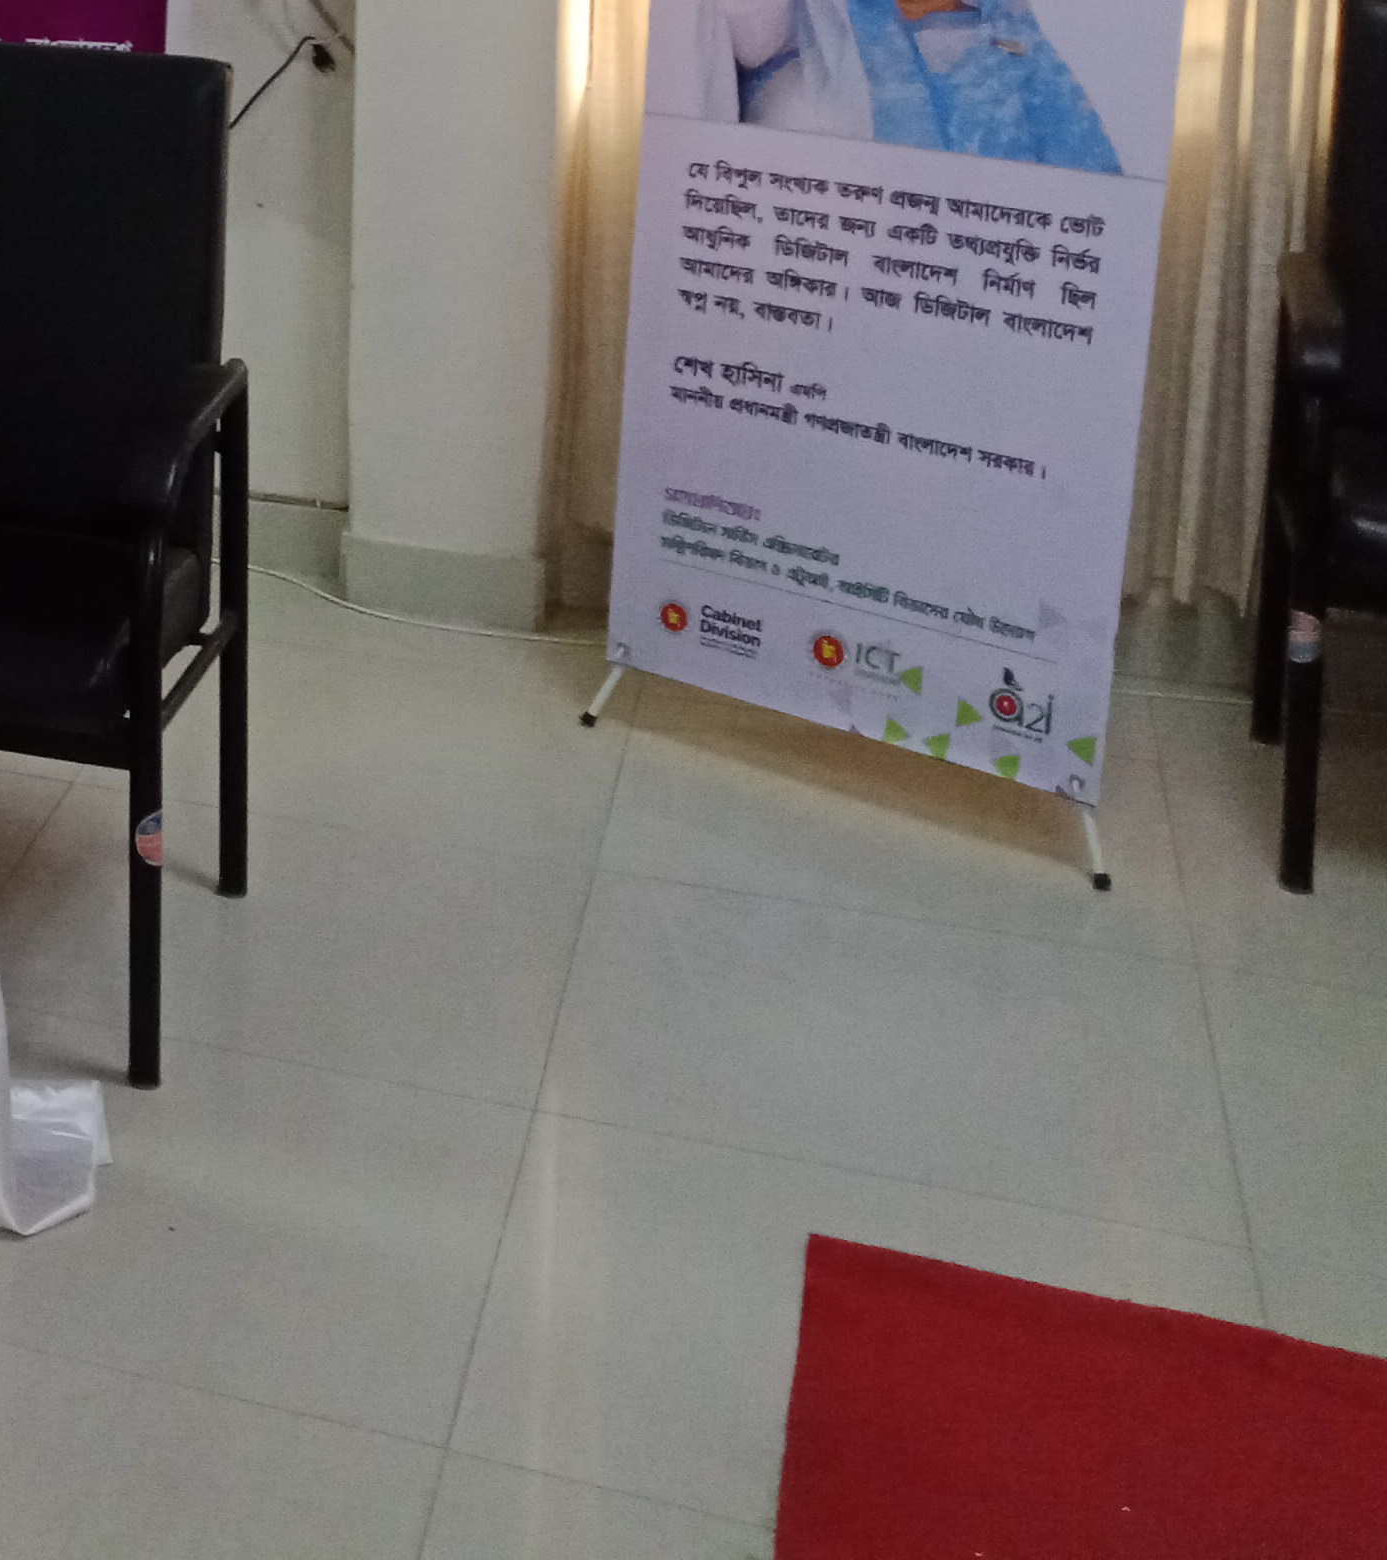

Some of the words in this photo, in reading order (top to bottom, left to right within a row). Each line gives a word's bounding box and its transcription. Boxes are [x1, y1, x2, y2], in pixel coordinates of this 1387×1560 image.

[688, 161, 710, 180] যে
[715, 159, 762, 189] বিপুল
[946, 196, 1053, 231] আমাদেরকে
[1059, 212, 1105, 238] ভোট
[772, 203, 830, 231] তাদের
[839, 214, 877, 239] জন্য
[886, 222, 939, 248] একটি
[1050, 243, 1102, 274] নির্ভর
[682, 223, 752, 252] আধুনিক
[773, 234, 849, 268] ডিজিটাল
[872, 254, 958, 286] বাংলাদেশ
[982, 268, 1035, 300] নির্মাণ
[1059, 281, 1097, 310] ছিল
[680, 256, 755, 285] আমাদের
[862, 286, 903, 310] আজ
[913, 291, 991, 327] ডিজিটাল
[1002, 311, 1093, 345] বাংলাদেশ
[674, 354, 714, 379] শেখ
[720, 361, 784, 393] হাসিনা
[897, 430, 972, 462] বাংলাদেশ
[700, 604, 763, 633] Cabinet
[700, 618, 762, 648] Division
[855, 642, 902, 674] ICT
